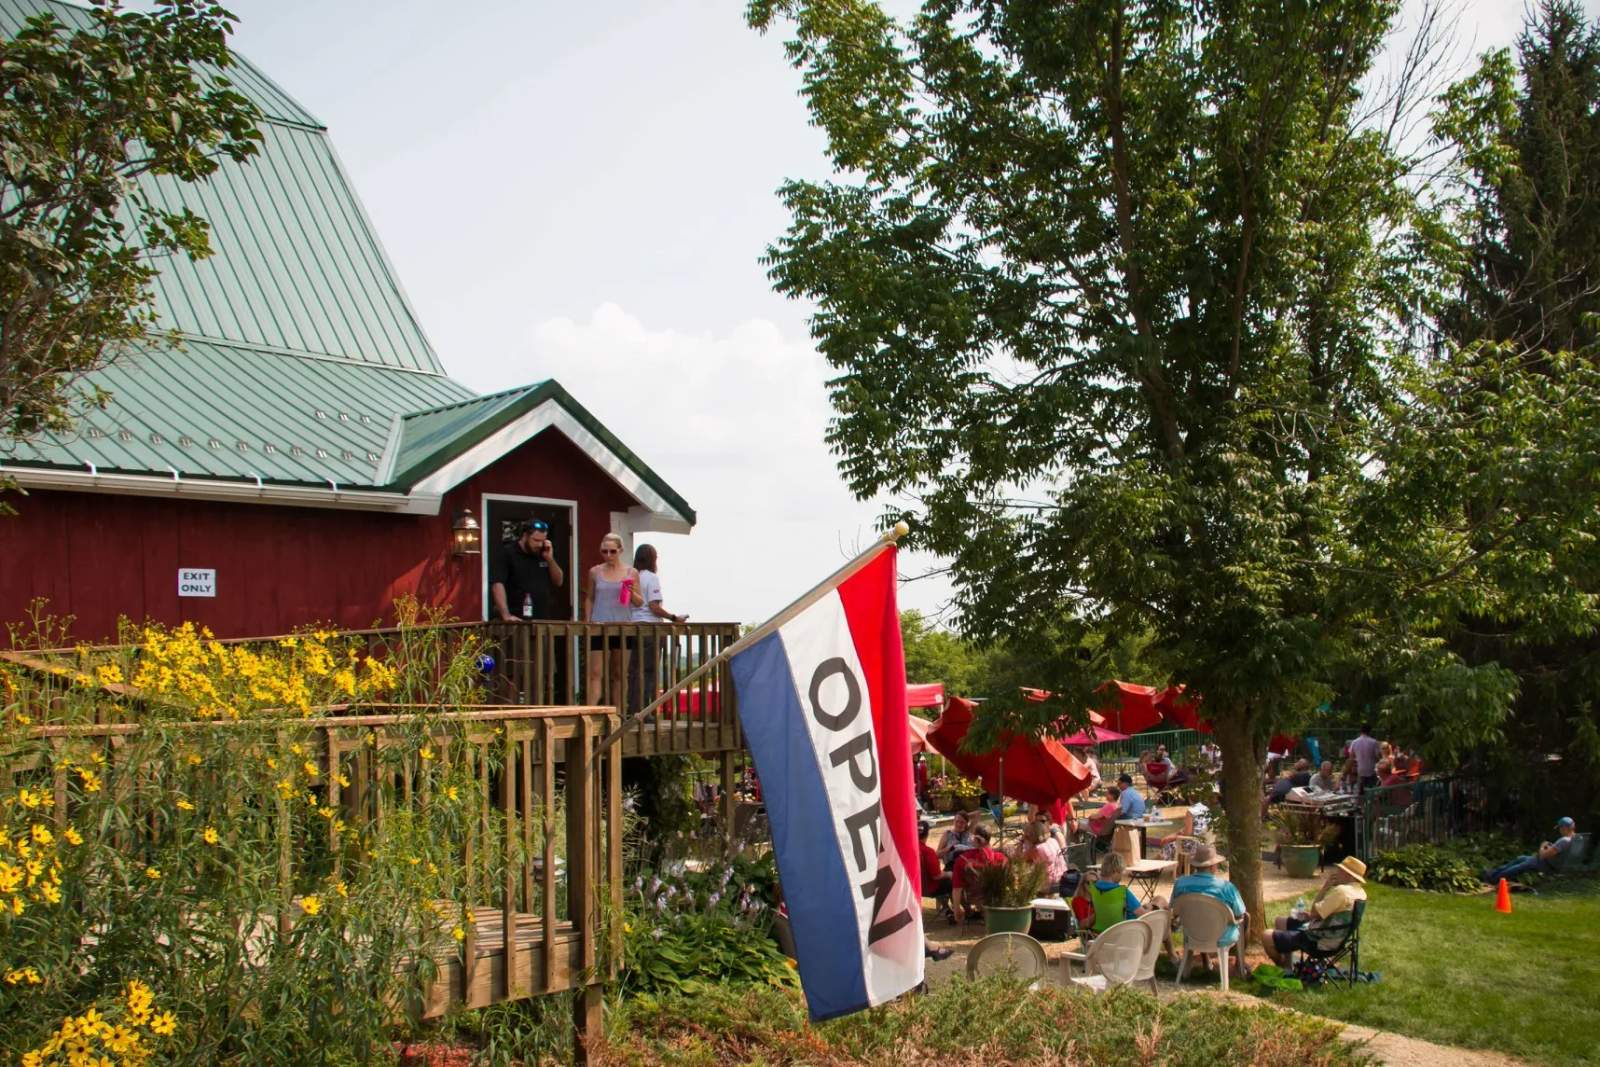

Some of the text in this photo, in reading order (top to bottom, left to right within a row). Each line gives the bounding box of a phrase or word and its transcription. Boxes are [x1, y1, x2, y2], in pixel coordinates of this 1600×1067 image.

[183, 572, 210, 580] EXIT
[181, 584, 211, 592] ONLY
[808, 656, 913, 947] OPEN
